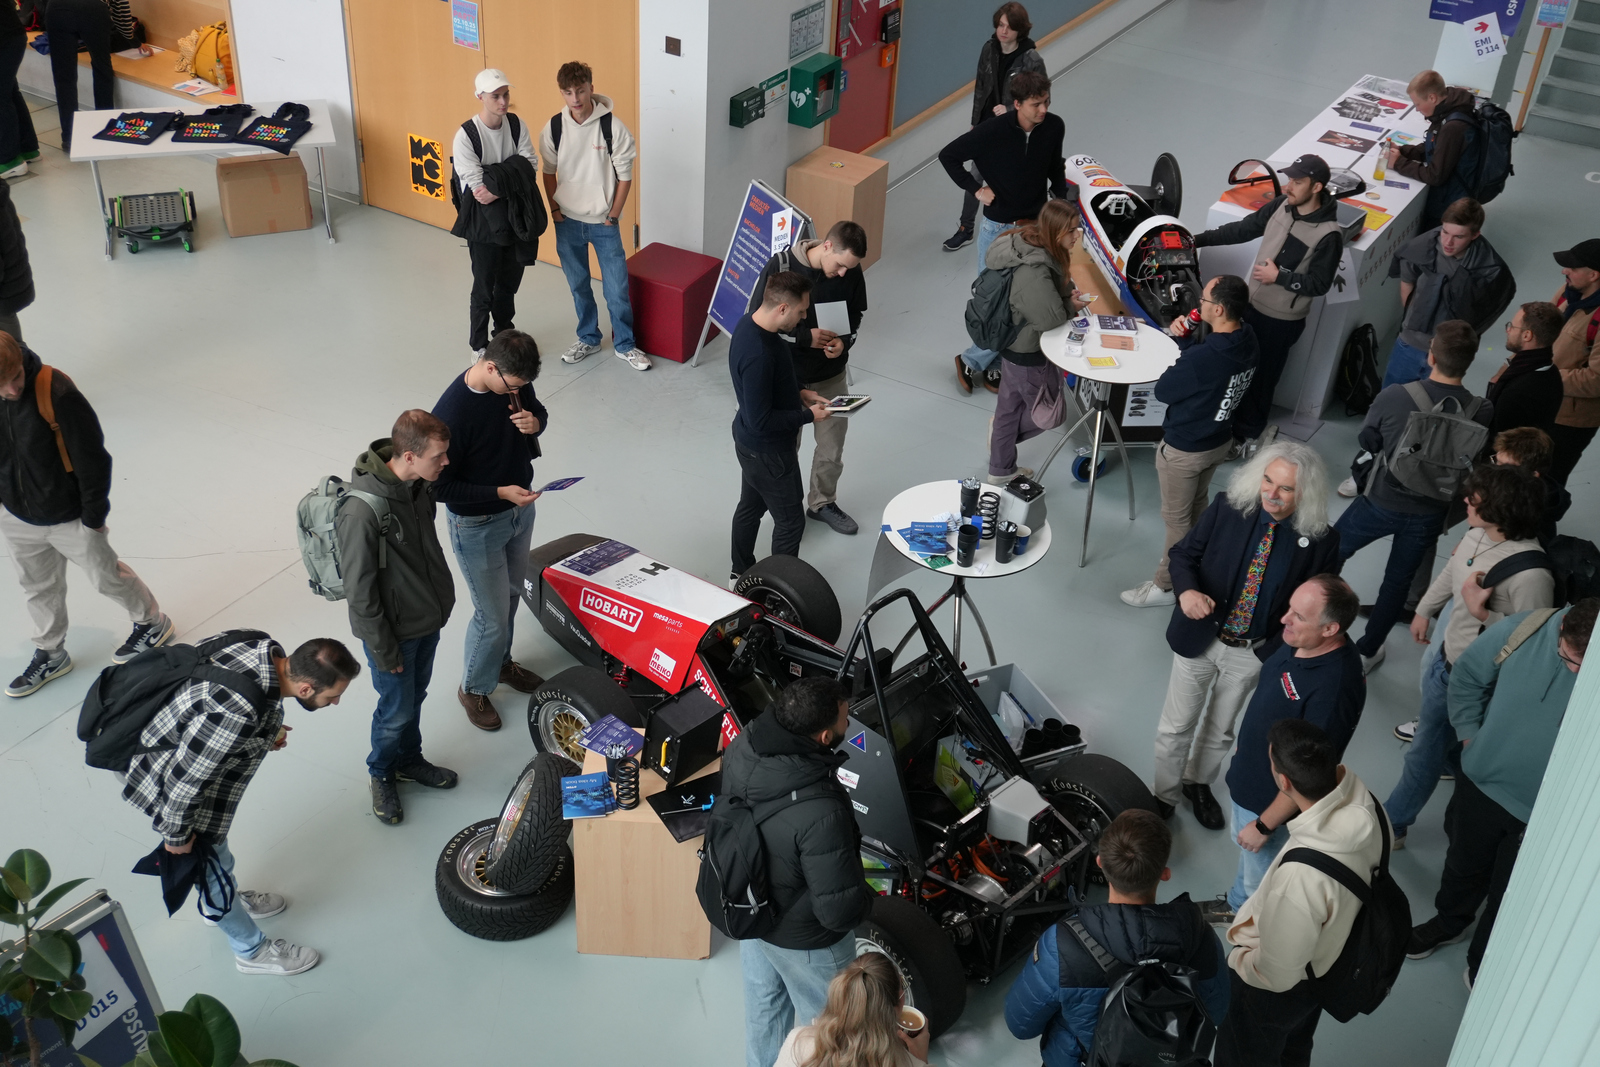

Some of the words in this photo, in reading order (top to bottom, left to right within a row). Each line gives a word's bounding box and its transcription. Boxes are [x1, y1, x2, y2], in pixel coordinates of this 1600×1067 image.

[453, 10, 476, 23] PARTY
[453, 17, 476, 29] 02.10.25
[1474, 37, 1492, 48] EMI
[1485, 44, 1500, 54] 114
[749, 200, 765, 216] MEDIEN
[774, 232, 788, 241] MEDIEN
[733, 574, 763, 596] Hoosier
[585, 594, 637, 623] HOBART
[535, 689, 572, 705] Hoosier
[1051, 777, 1096, 798] Hoosier
[444, 826, 476, 864] Hoosier
[870, 929, 914, 983] Hoosier
[89, 990, 119, 1020] 015
[122, 1004, 149, 1056] AUSG
